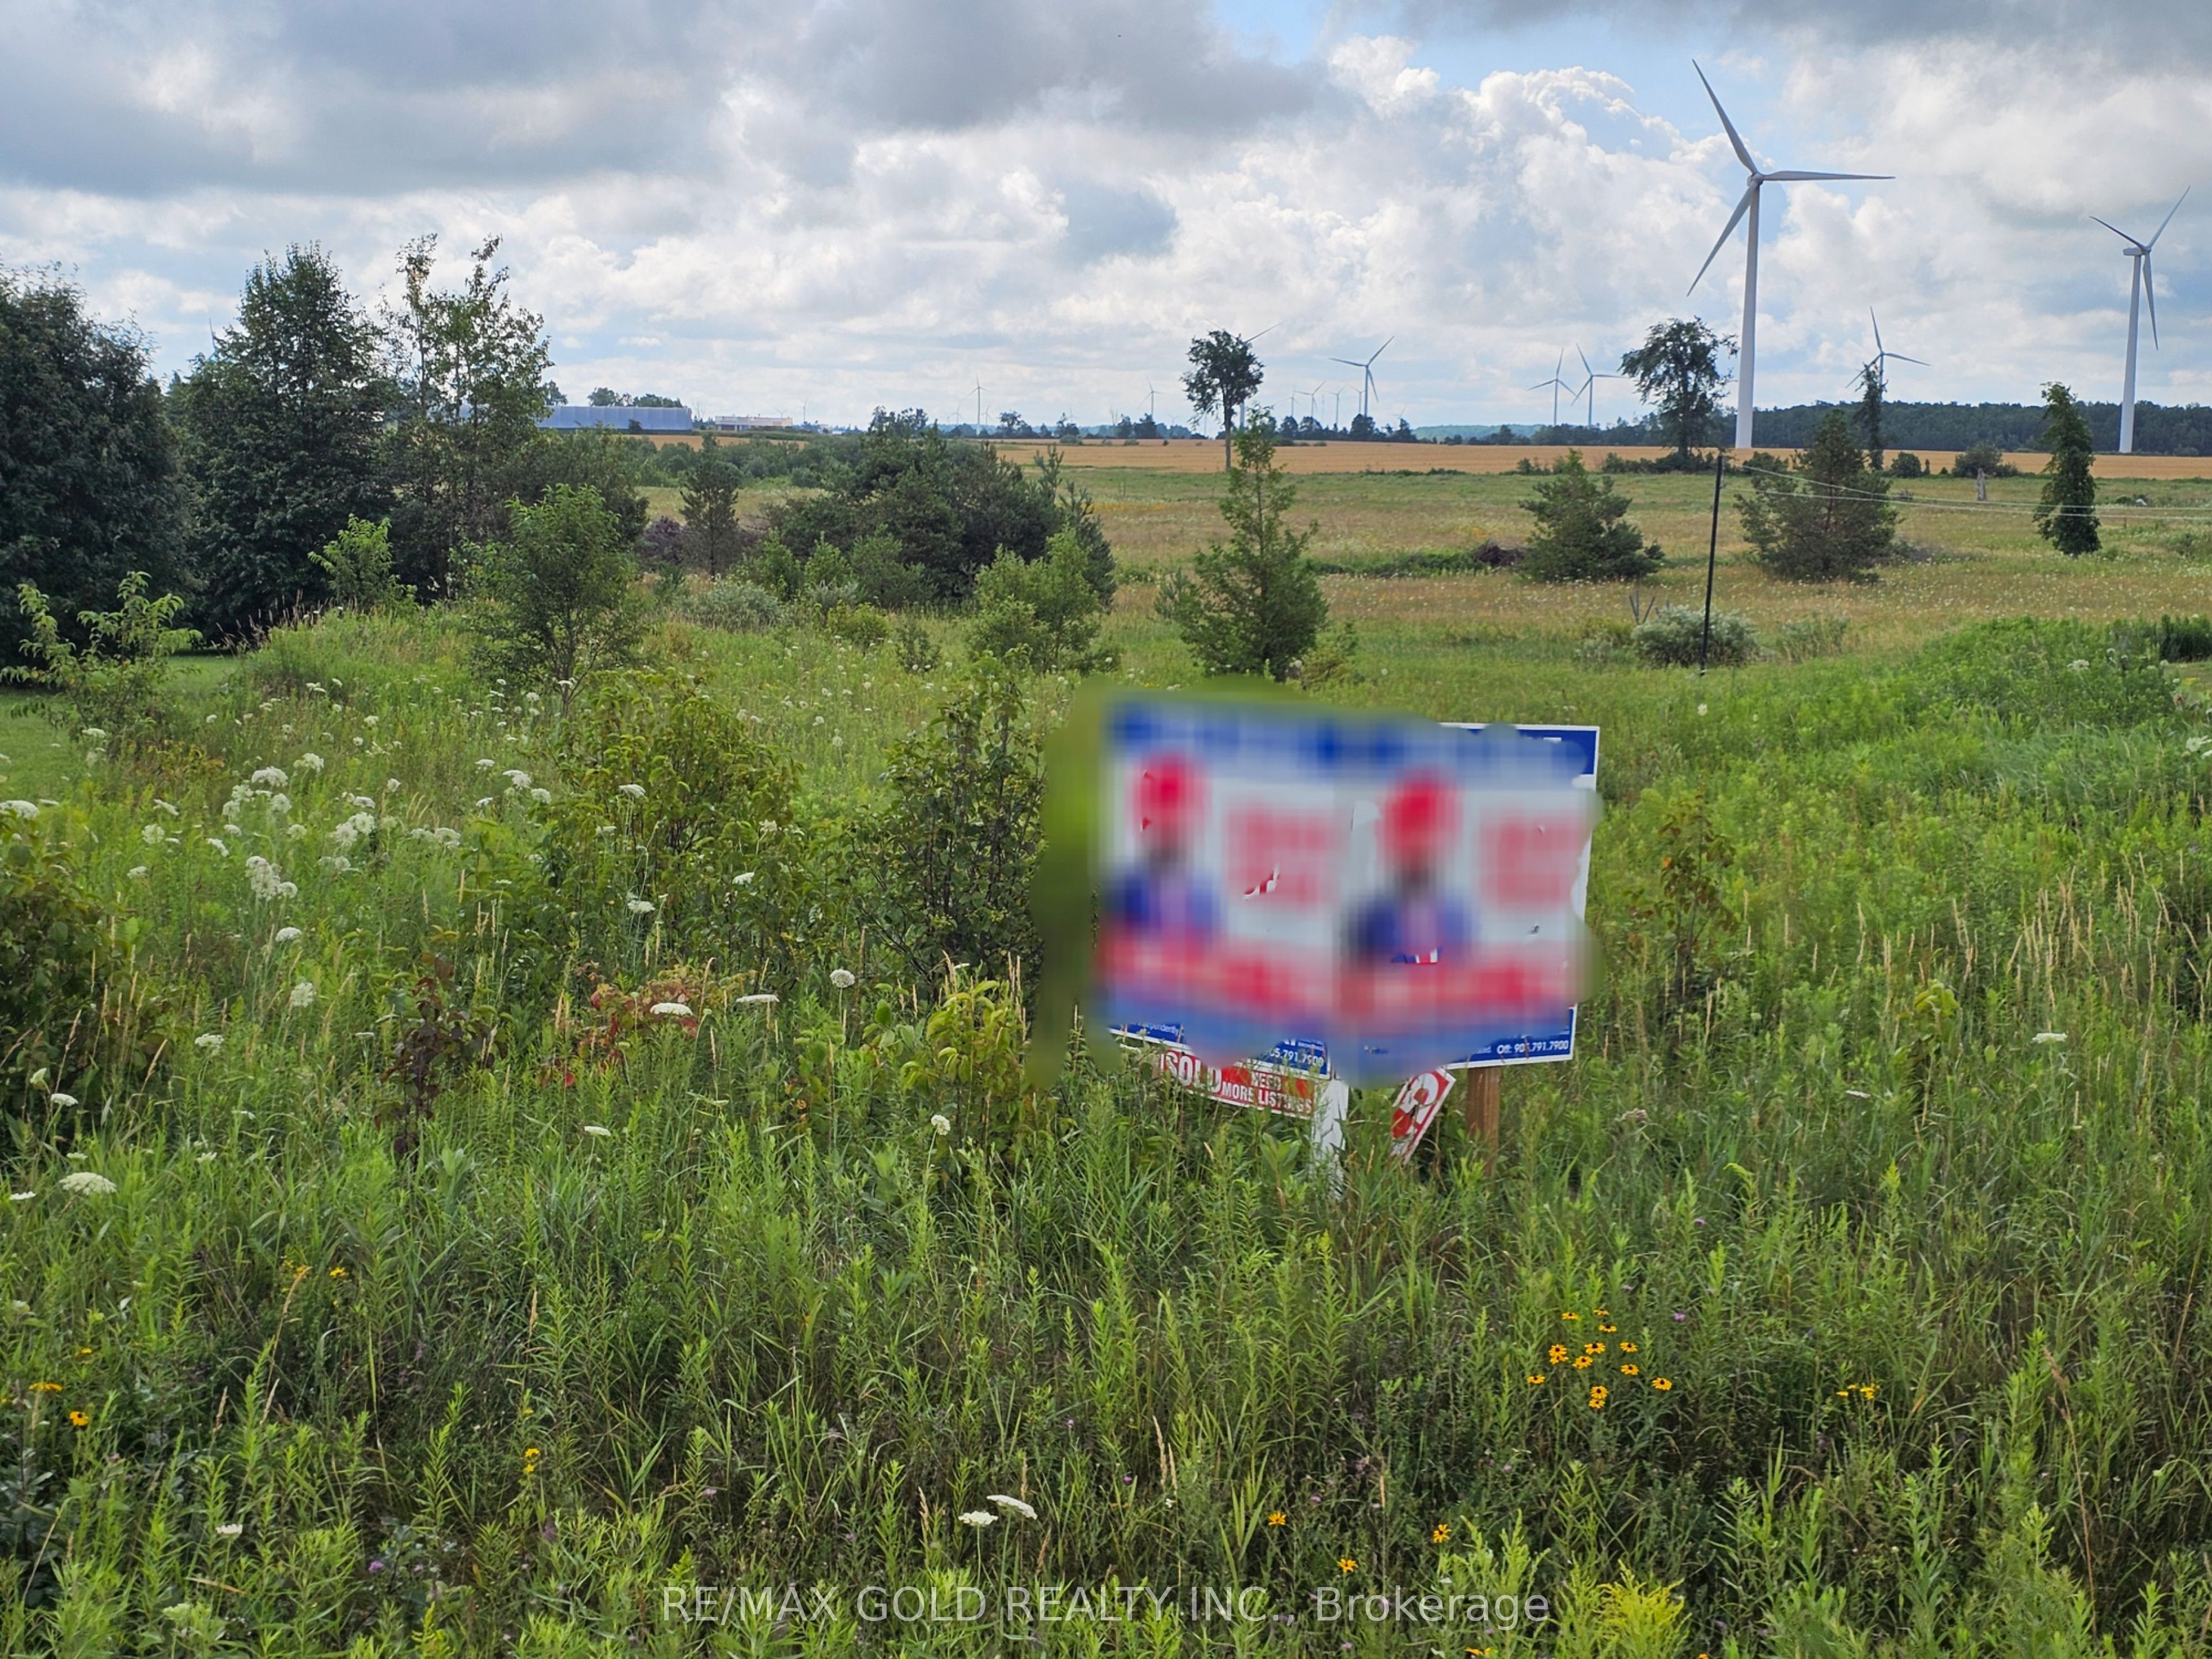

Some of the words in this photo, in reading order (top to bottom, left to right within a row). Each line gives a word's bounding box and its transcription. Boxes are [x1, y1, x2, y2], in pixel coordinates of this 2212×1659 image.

[1269, 1047, 1324, 1067] 05.791.7900
[1165, 1052, 1222, 1092] SOLD
[1222, 1082, 1255, 1103] MORE
